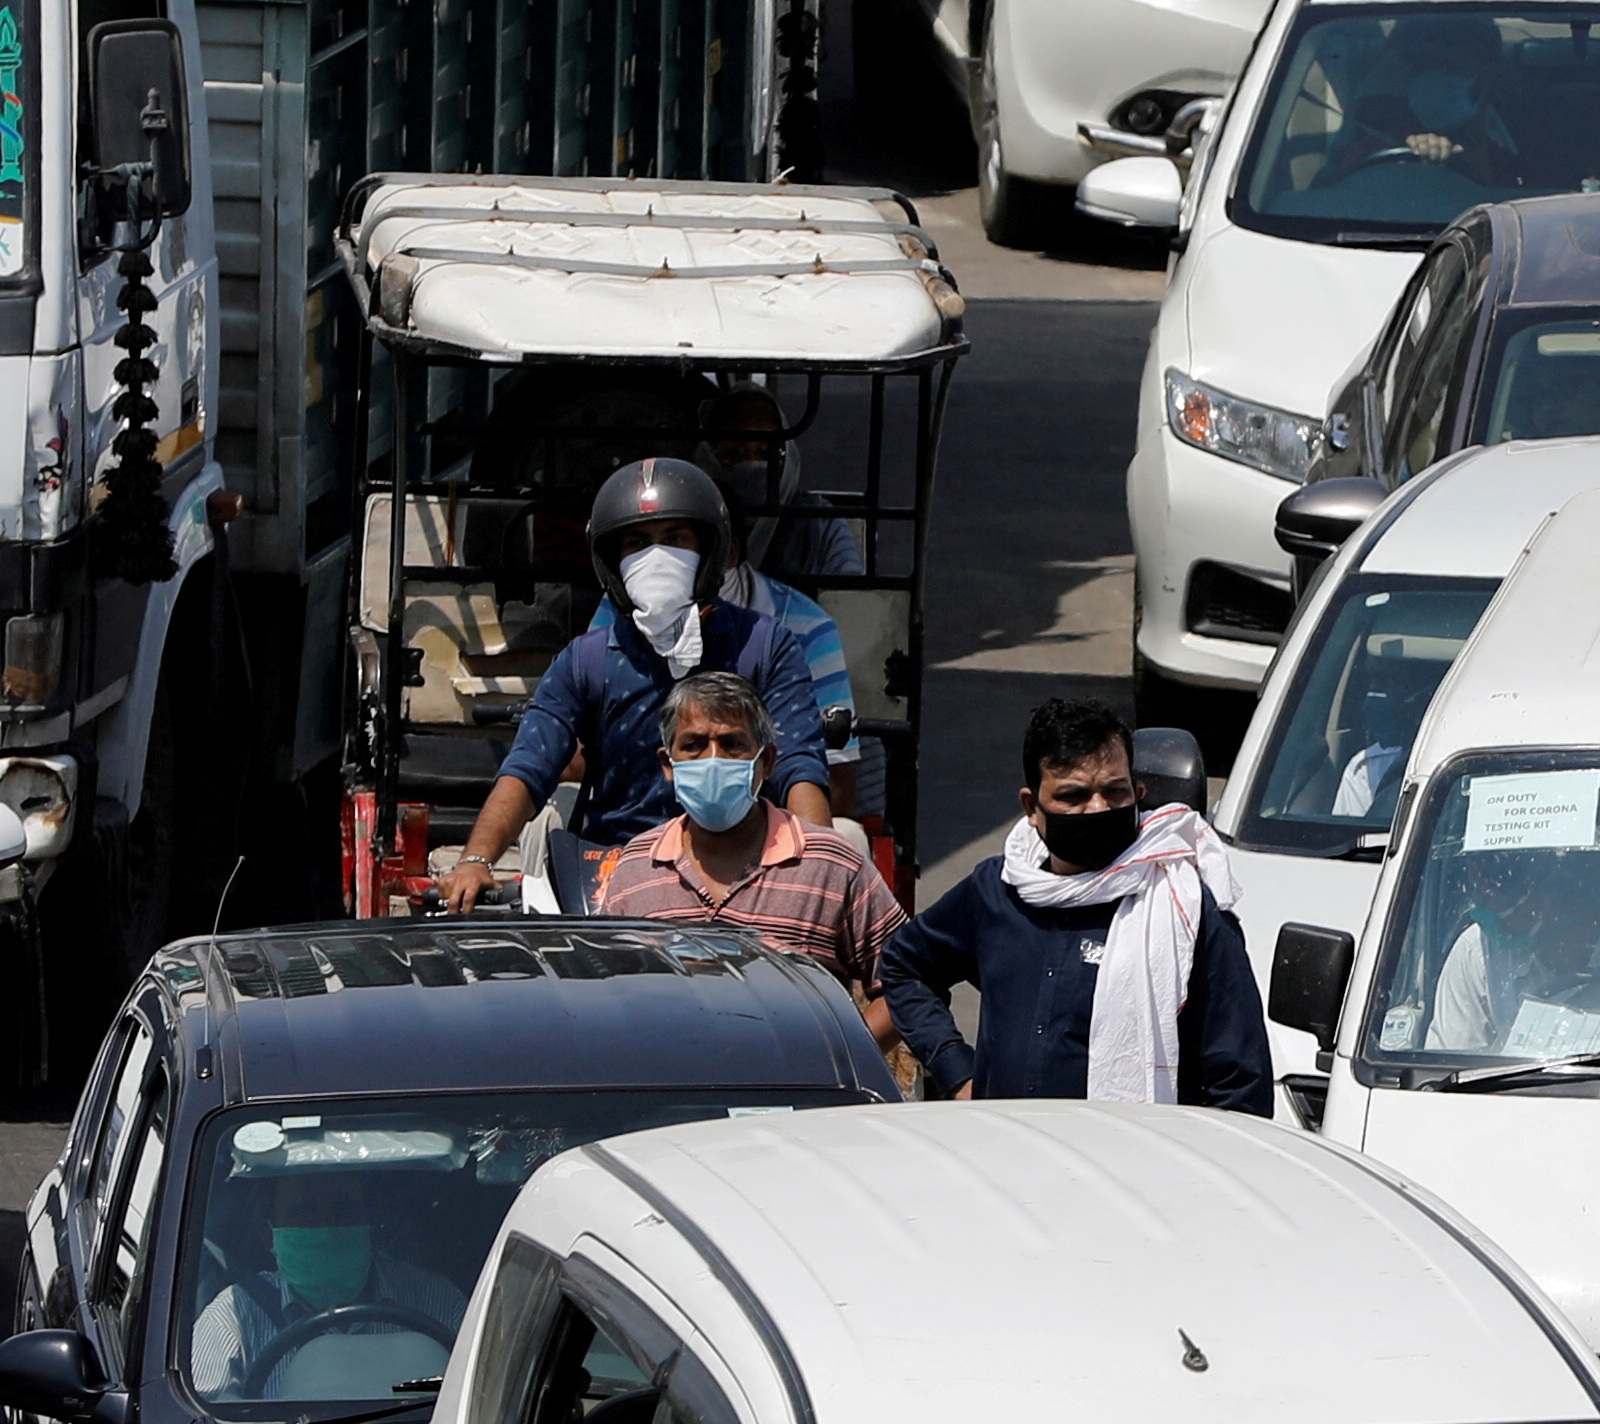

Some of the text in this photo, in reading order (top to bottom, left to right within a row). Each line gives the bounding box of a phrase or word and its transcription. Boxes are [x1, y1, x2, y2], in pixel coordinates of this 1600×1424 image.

[1486, 792, 1538, 806] ON DUTY
[1504, 803, 1578, 817] FOR CORONA
[1485, 819, 1551, 832] TESTING KIT
[1483, 834, 1525, 847] SUPPLY
